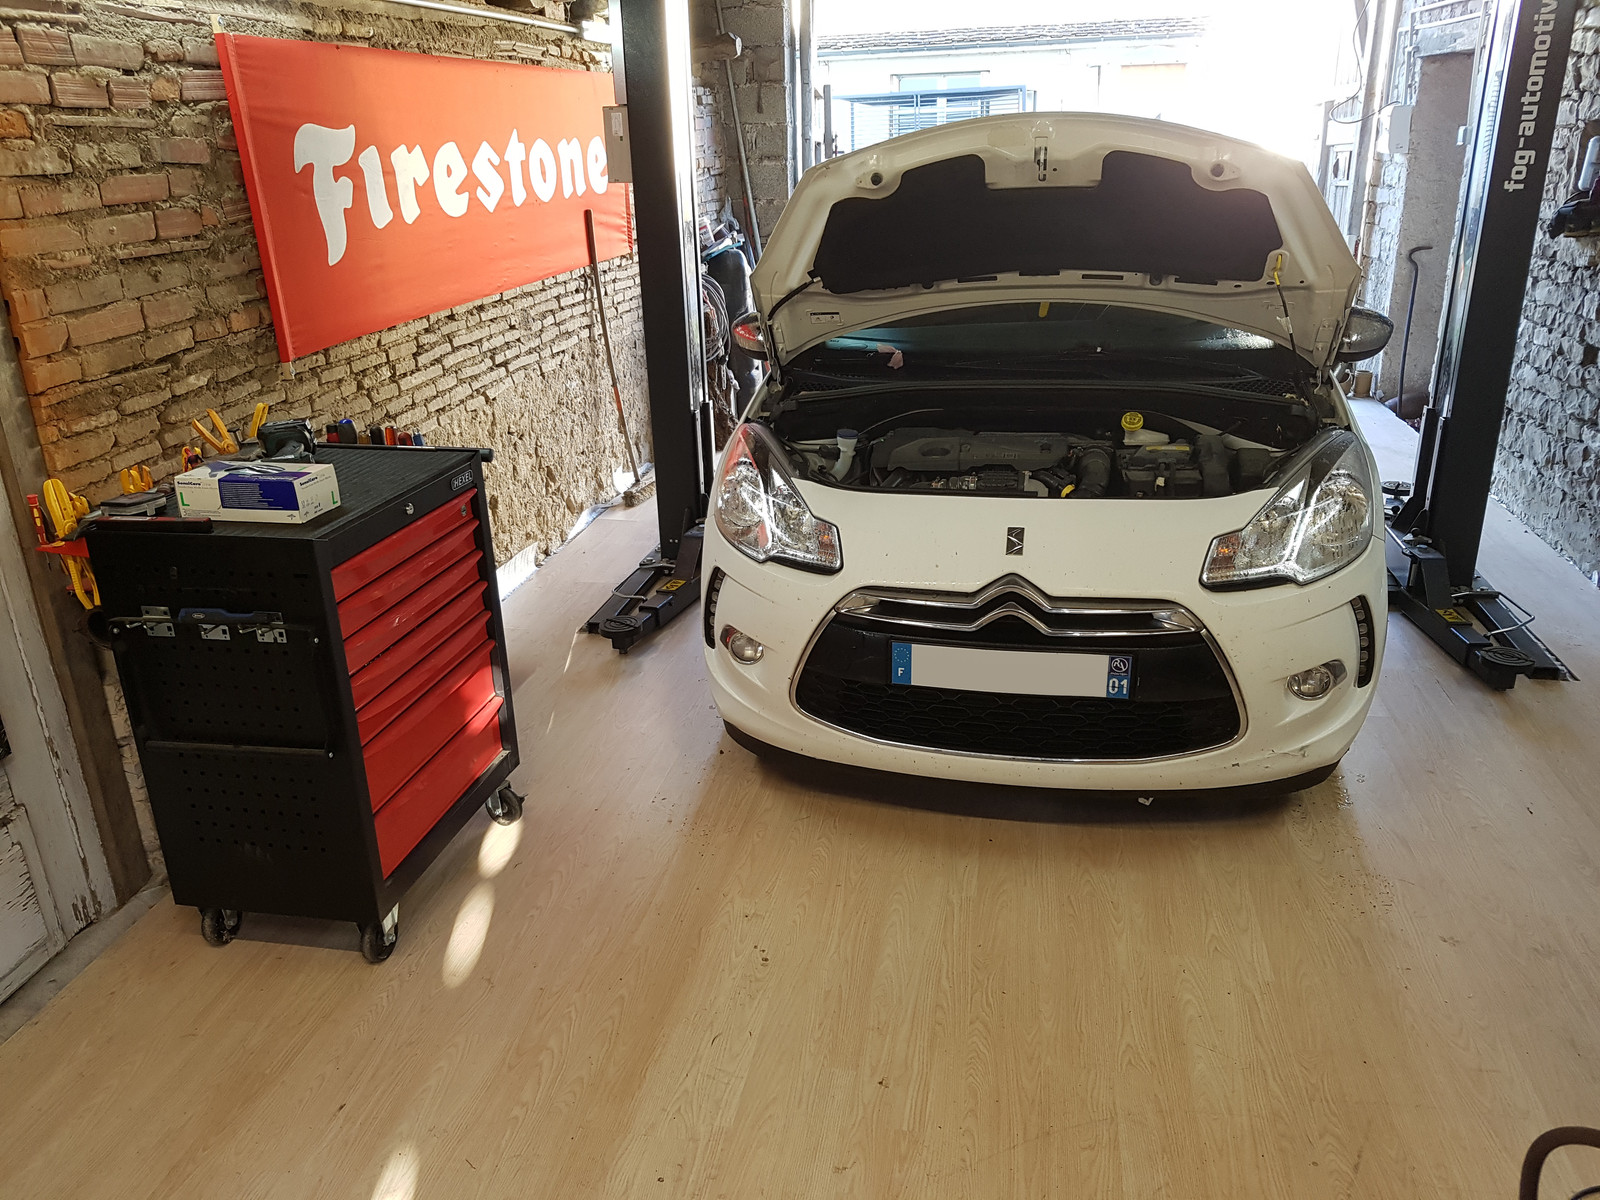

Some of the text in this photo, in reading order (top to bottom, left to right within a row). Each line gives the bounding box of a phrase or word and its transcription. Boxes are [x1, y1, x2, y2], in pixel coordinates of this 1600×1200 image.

[293, 123, 608, 266] Firestone
[453, 470, 473, 488] HEXEL
[180, 492, 190, 506] L
[331, 490, 338, 505] L
[897, 667, 905, 677] F
[1108, 678, 1128, 695] 01
